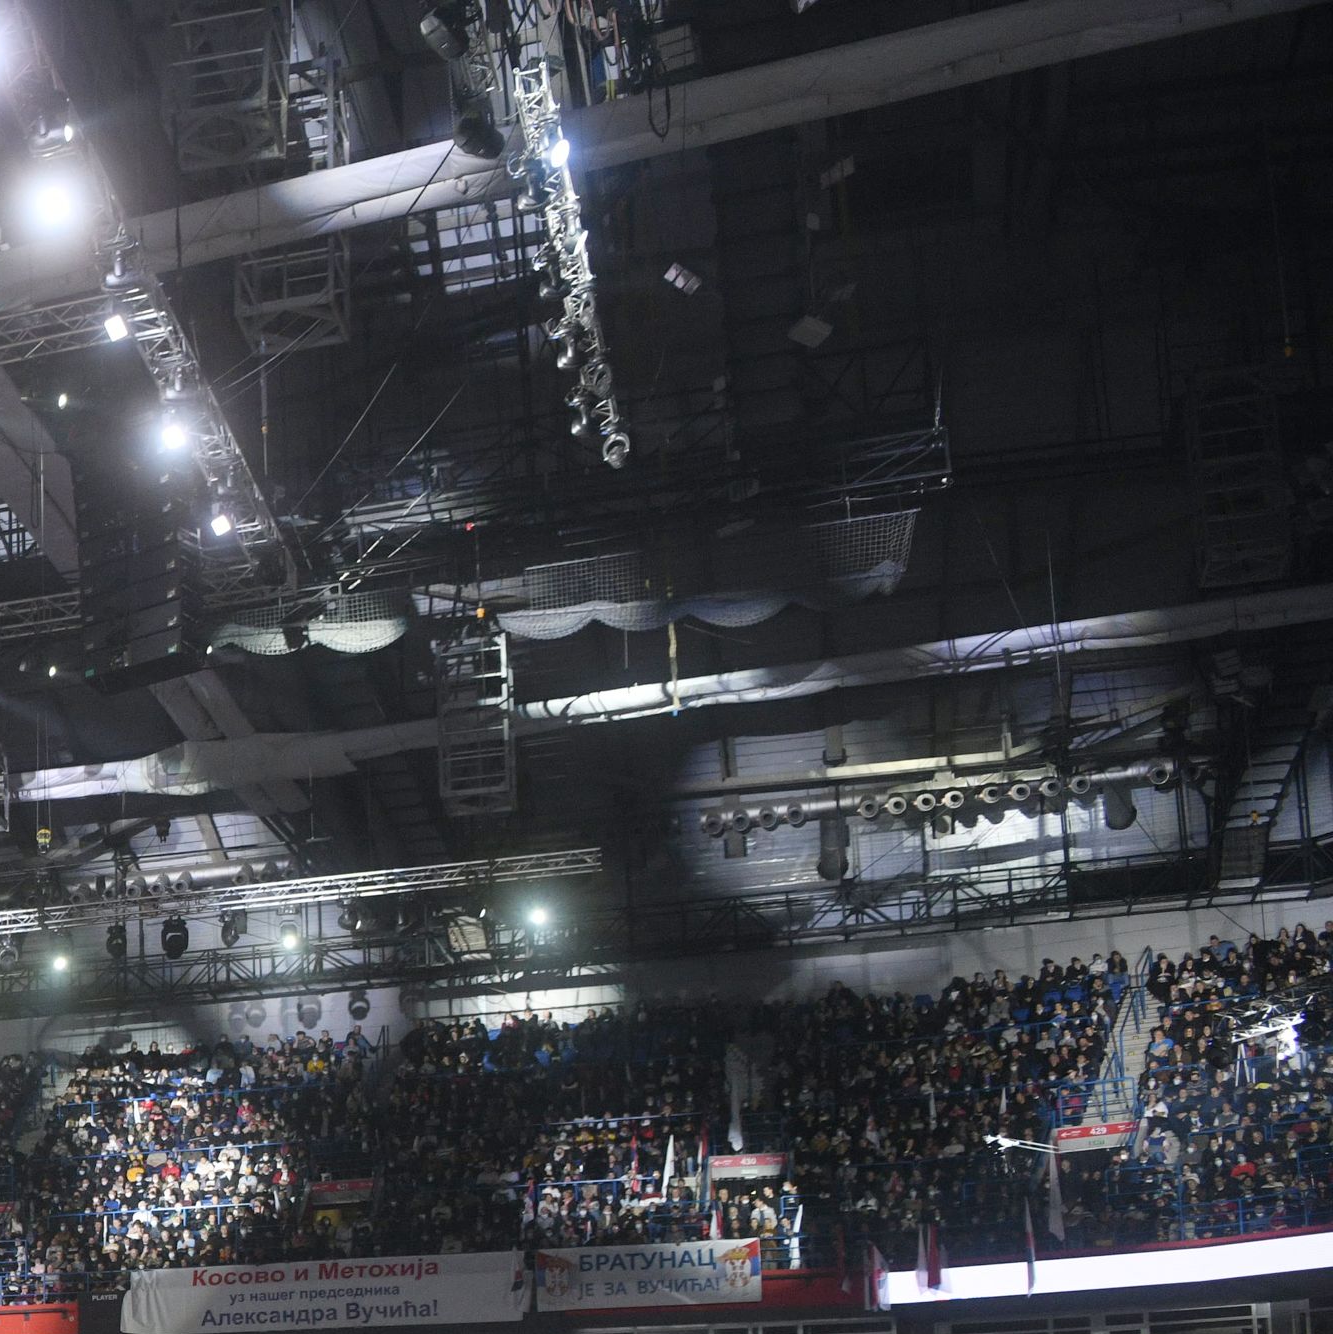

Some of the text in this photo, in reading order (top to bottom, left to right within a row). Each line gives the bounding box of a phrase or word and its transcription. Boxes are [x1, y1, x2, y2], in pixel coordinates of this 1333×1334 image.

[1091, 1127, 1107, 1136] 429
[579, 1249, 717, 1272] БРАТУНАЦ
[191, 1260, 439, 1287] Косово и Метохија
[229, 1285, 400, 1305] уз нашег председника
[578, 1278, 721, 1300] ЈЕ ЗА ВУЧИЋА!
[201, 1300, 439, 1327] Александра Вучића!
